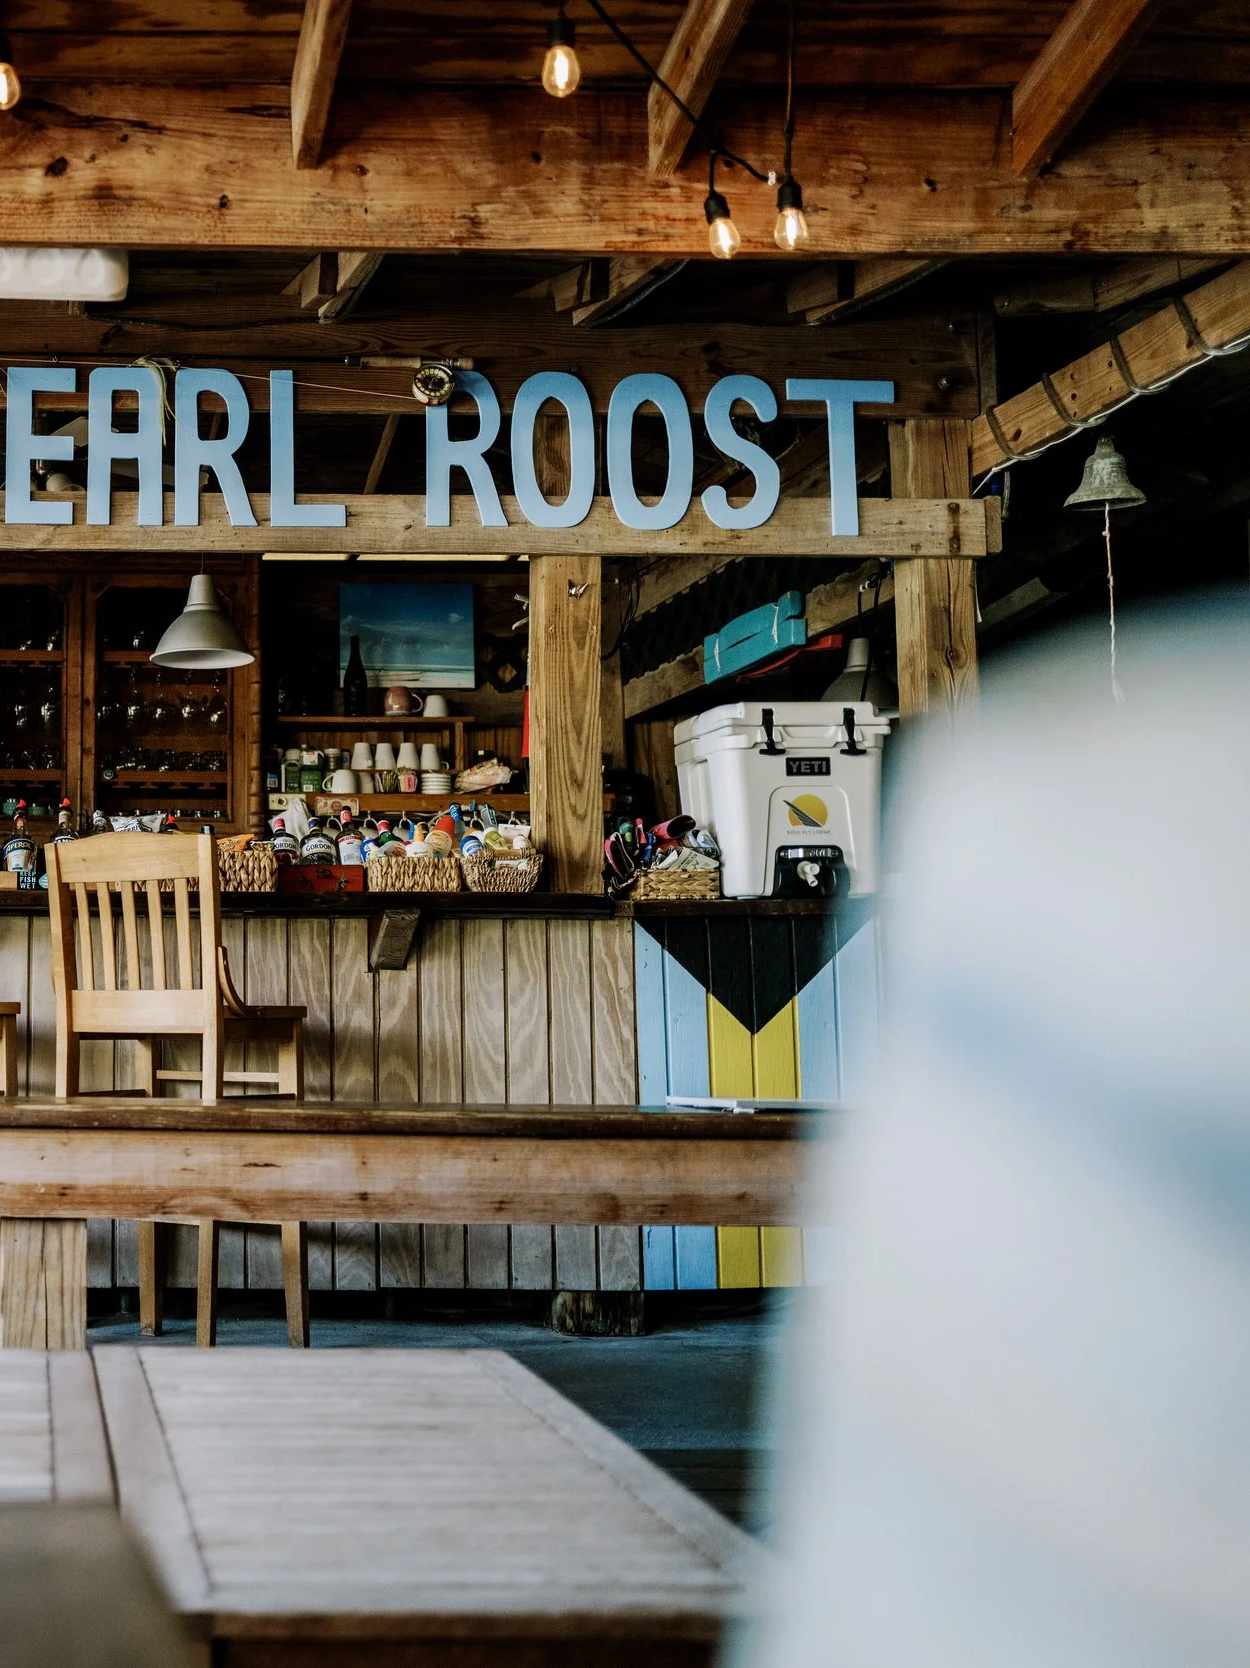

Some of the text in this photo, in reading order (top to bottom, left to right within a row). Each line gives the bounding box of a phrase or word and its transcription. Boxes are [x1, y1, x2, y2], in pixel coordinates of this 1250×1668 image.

[424, 370, 895, 537] ROOST
[788, 760, 827, 773] YETI
[6, 840, 32, 855] APEROL
[305, 842, 334, 852] GORDON'
[19, 882, 36, 890] WET
